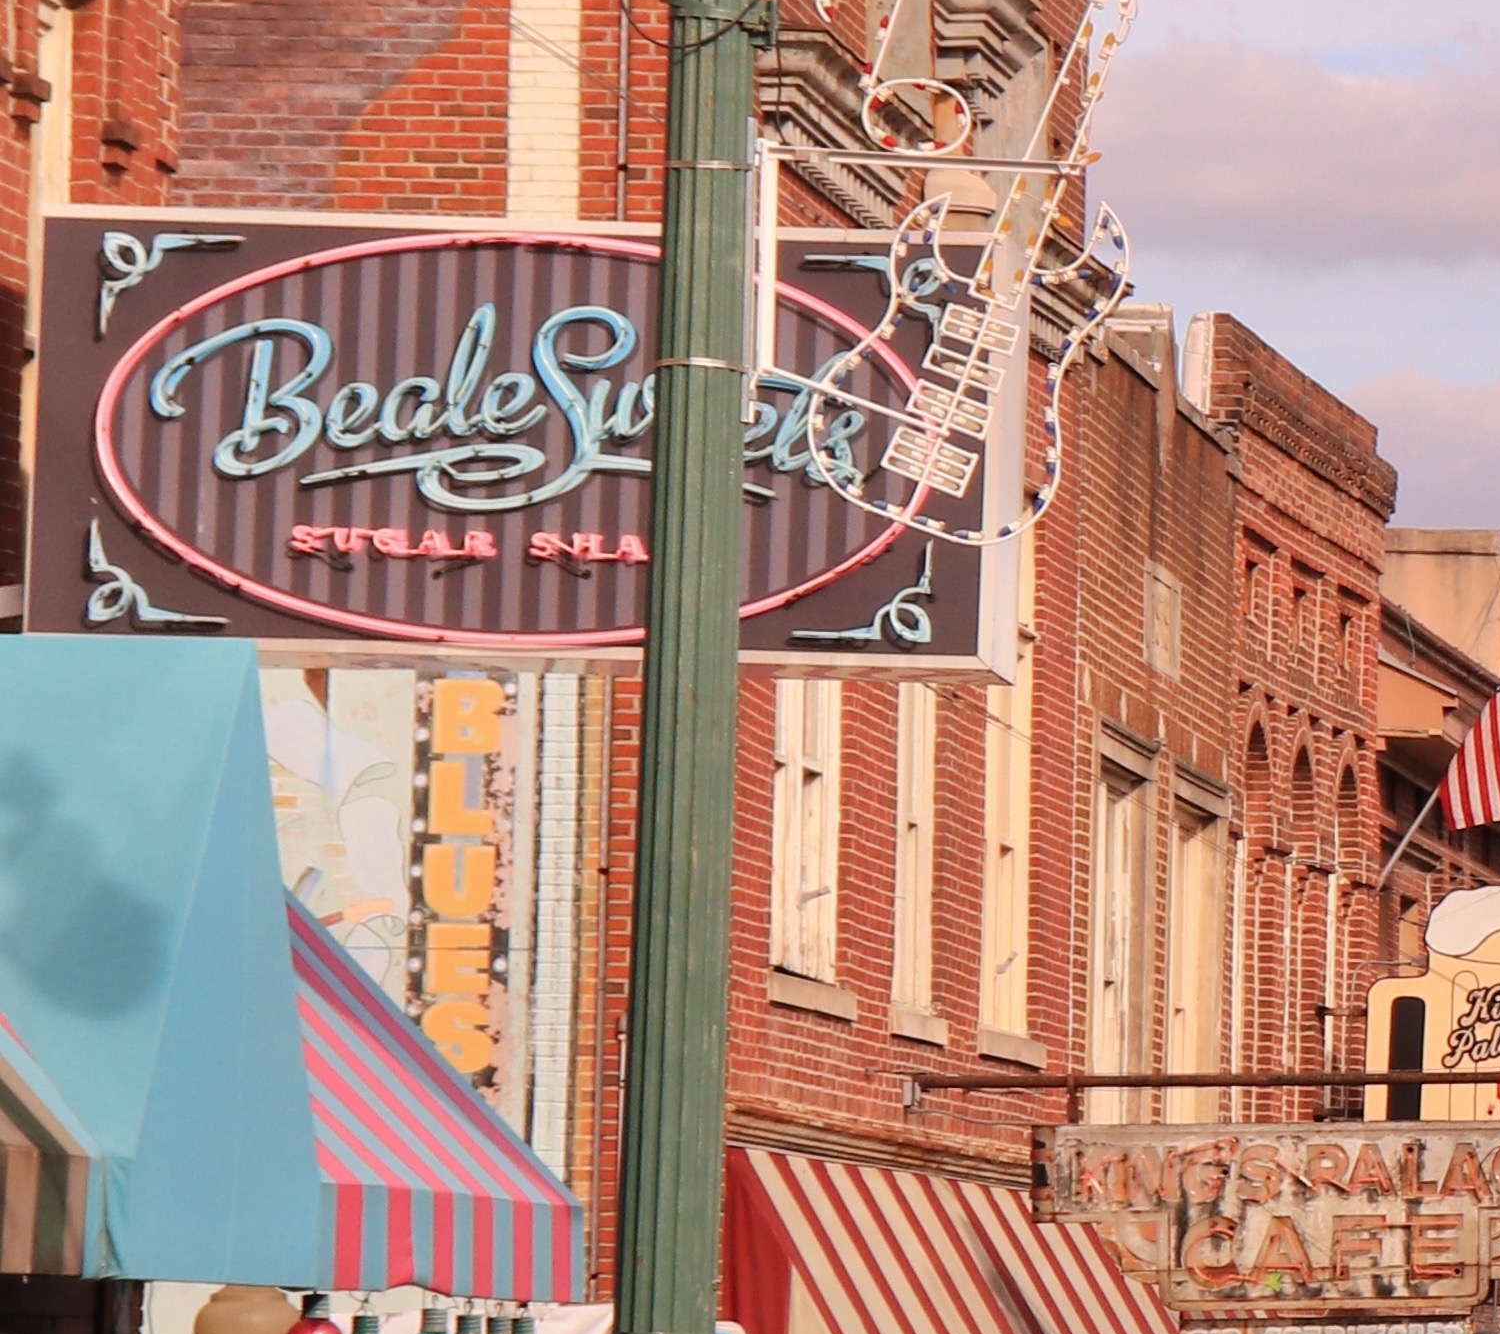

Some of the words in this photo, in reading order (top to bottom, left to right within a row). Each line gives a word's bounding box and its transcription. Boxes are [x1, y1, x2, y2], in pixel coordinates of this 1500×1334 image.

[148, 301, 546, 480] Beale
[420, 304, 868, 510] Swets
[290, 522, 497, 559] SUGAR
[422, 678, 508, 1073] BLUES
[1183, 1213, 1464, 1285] CAFE
